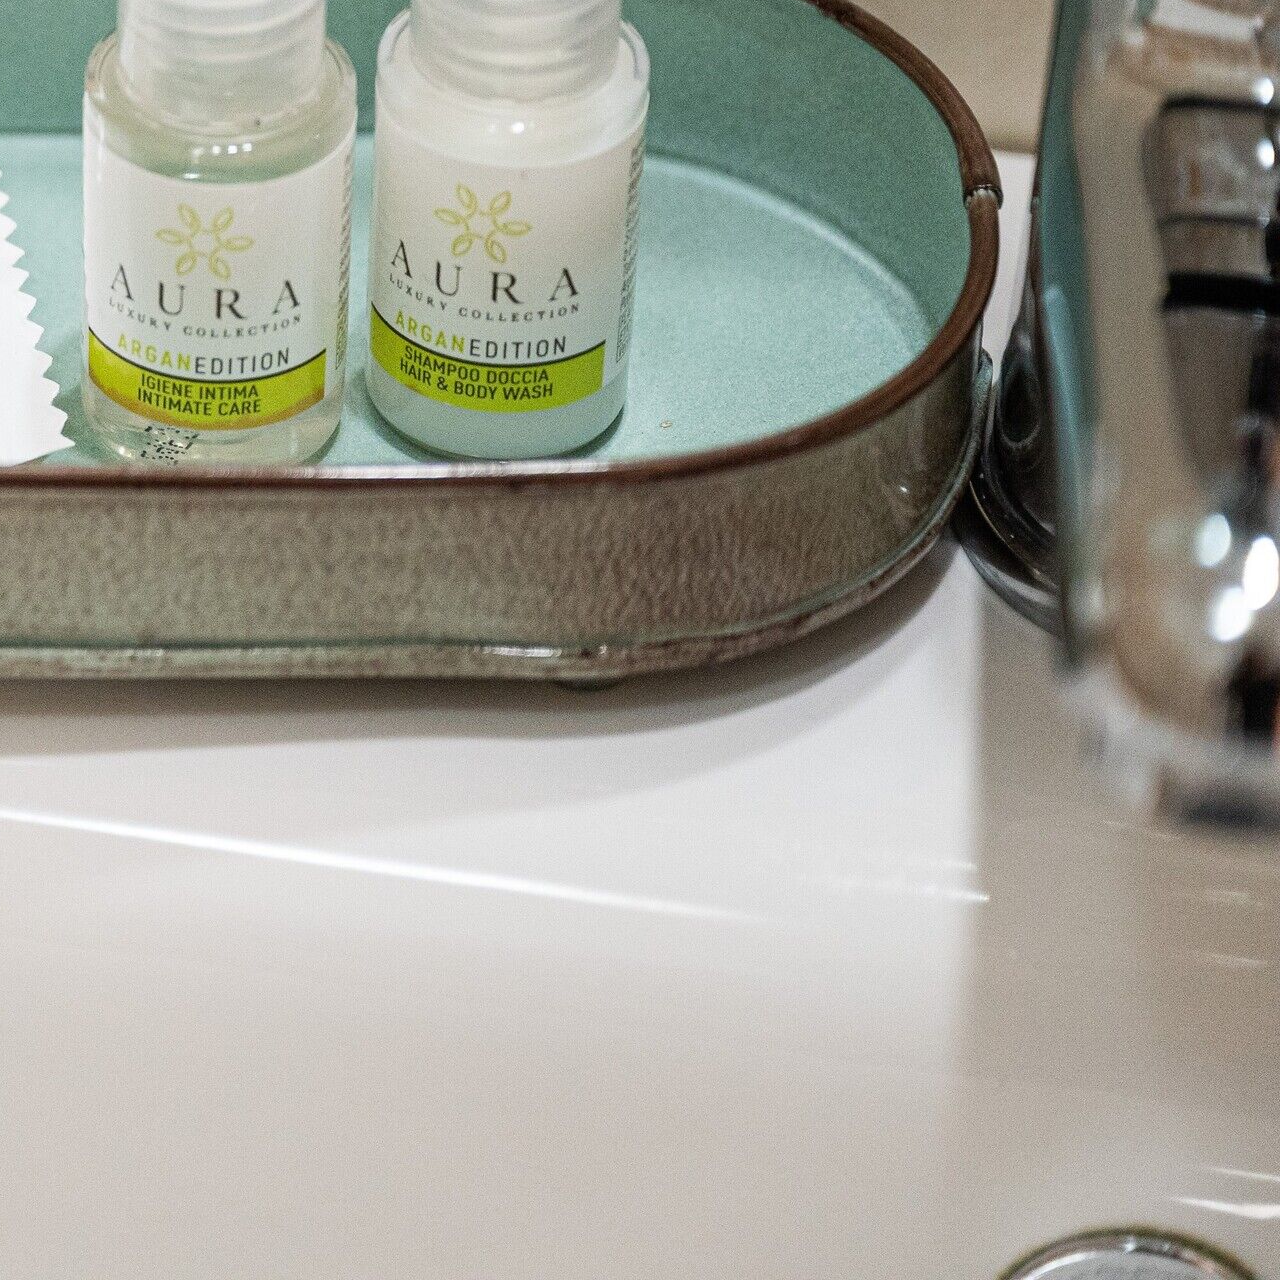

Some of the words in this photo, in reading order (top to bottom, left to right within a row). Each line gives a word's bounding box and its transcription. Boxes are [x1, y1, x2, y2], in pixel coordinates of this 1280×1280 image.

[110, 264, 301, 320] AURA
[391, 238, 579, 305] AURA
[109, 297, 172, 331] LUXURY
[183, 314, 302, 339] COLLECTION
[389, 273, 448, 311] LUXURY
[458, 303, 580, 322] COLLECTION
[400, 359, 432, 386] HAIR
[436, 376, 448, 392] &
[453, 381, 498, 401] BODY
[502, 383, 554, 401] WASH
[404, 345, 481, 382] SHAMPOO
[486, 369, 550, 385] DOCCIA
[138, 388, 212, 416] INTIMATE
[218, 399, 262, 416] CARE
[141, 373, 193, 399] IGIENE
[198, 385, 260, 401] INTIMA
